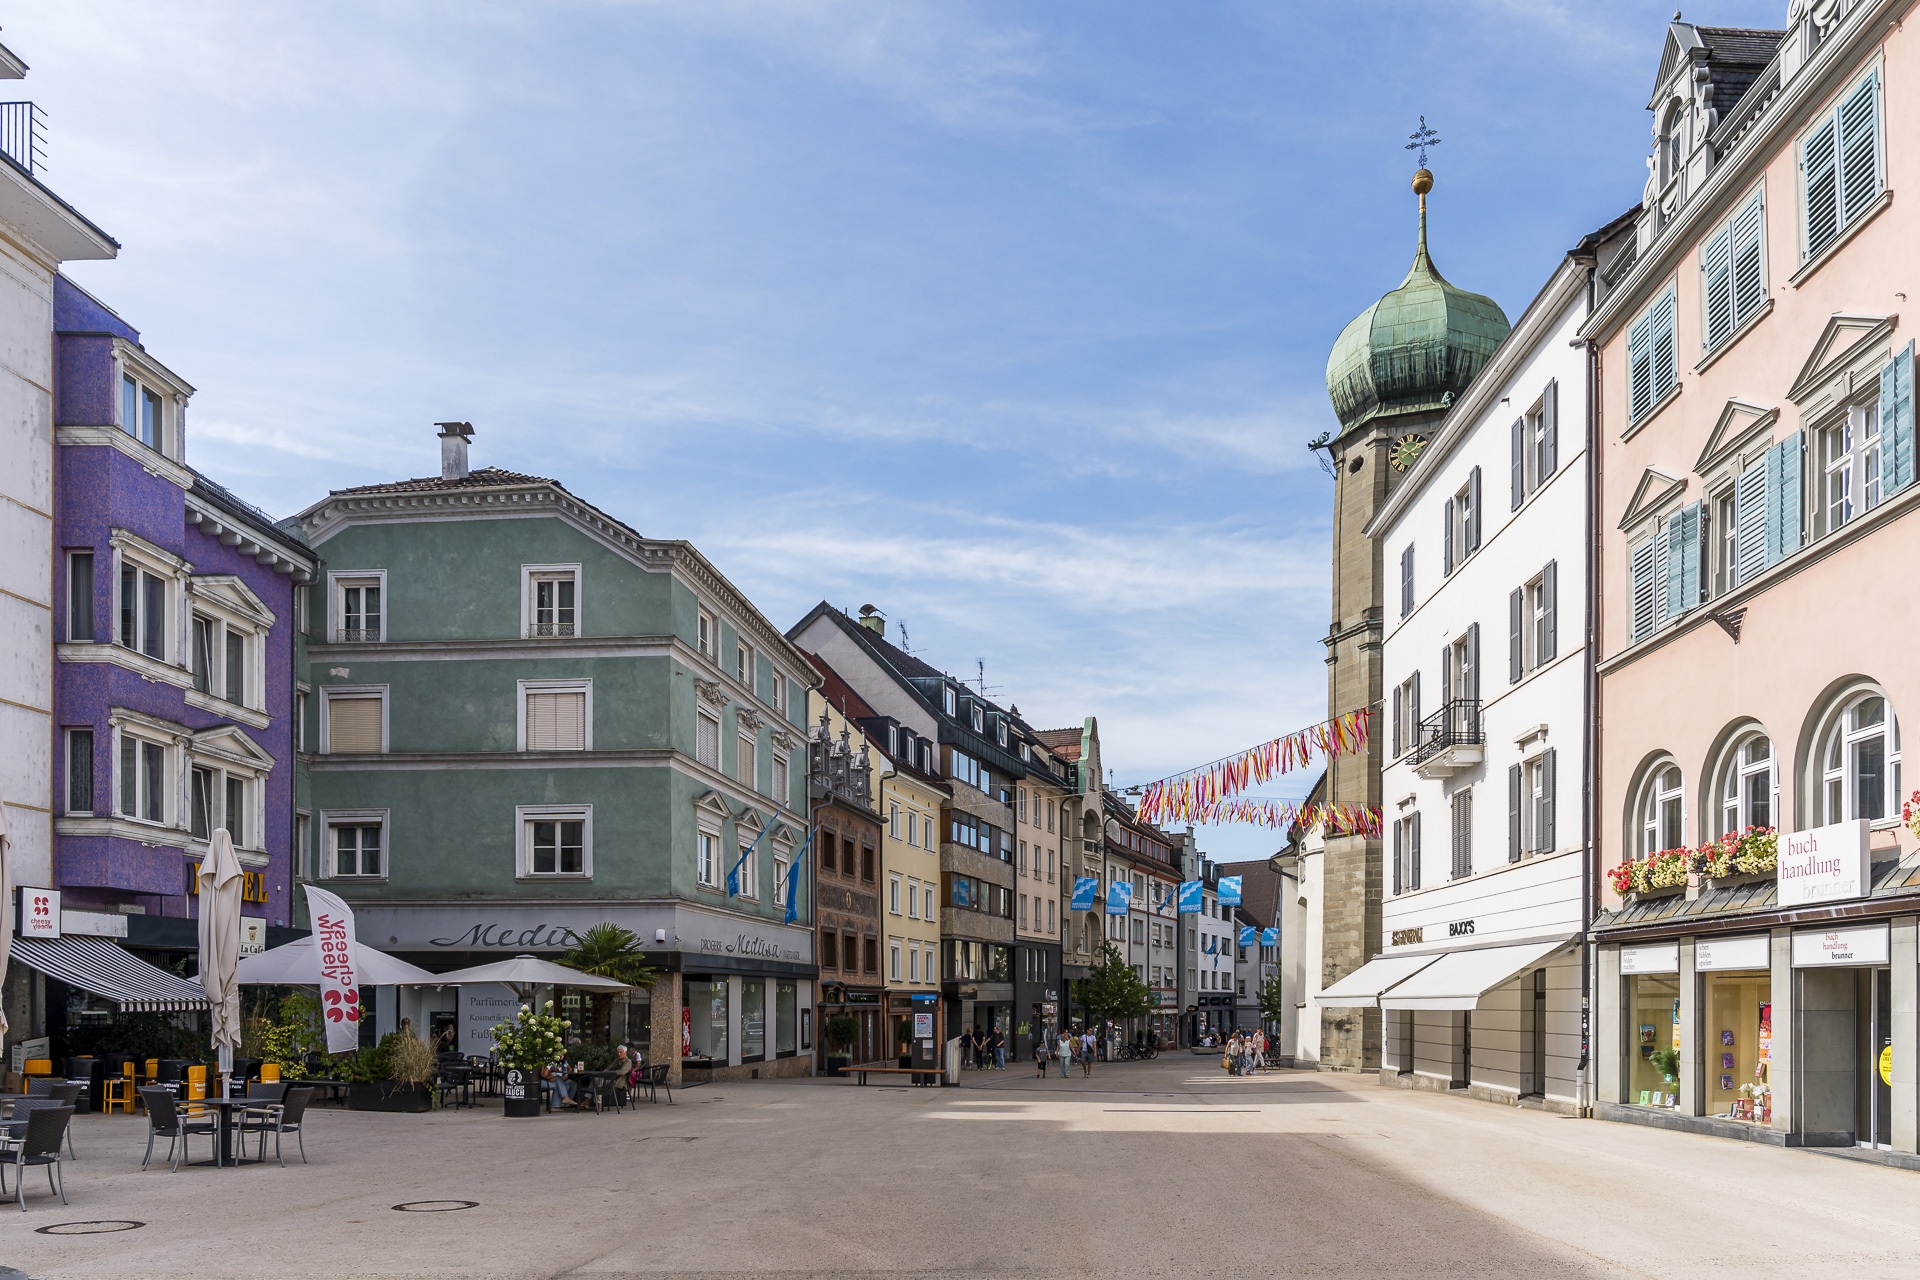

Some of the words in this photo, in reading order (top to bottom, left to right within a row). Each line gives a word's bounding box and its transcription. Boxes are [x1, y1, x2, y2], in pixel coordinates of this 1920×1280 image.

[1788, 833, 1817, 856] buch
[1782, 856, 1841, 879] handlung
[1803, 880, 1855, 899] brunner
[1449, 920, 1475, 937] BAXX'S
[1825, 932, 1838, 941] buch
[317, 913, 340, 980] wheely
[700, 939, 723, 952] DROGERIE
[1822, 941, 1848, 951] handlung
[1831, 951, 1853, 960] brunner
[470, 997, 520, 1007] Parfümerie
[505, 1088, 524, 1096] RAUCH
